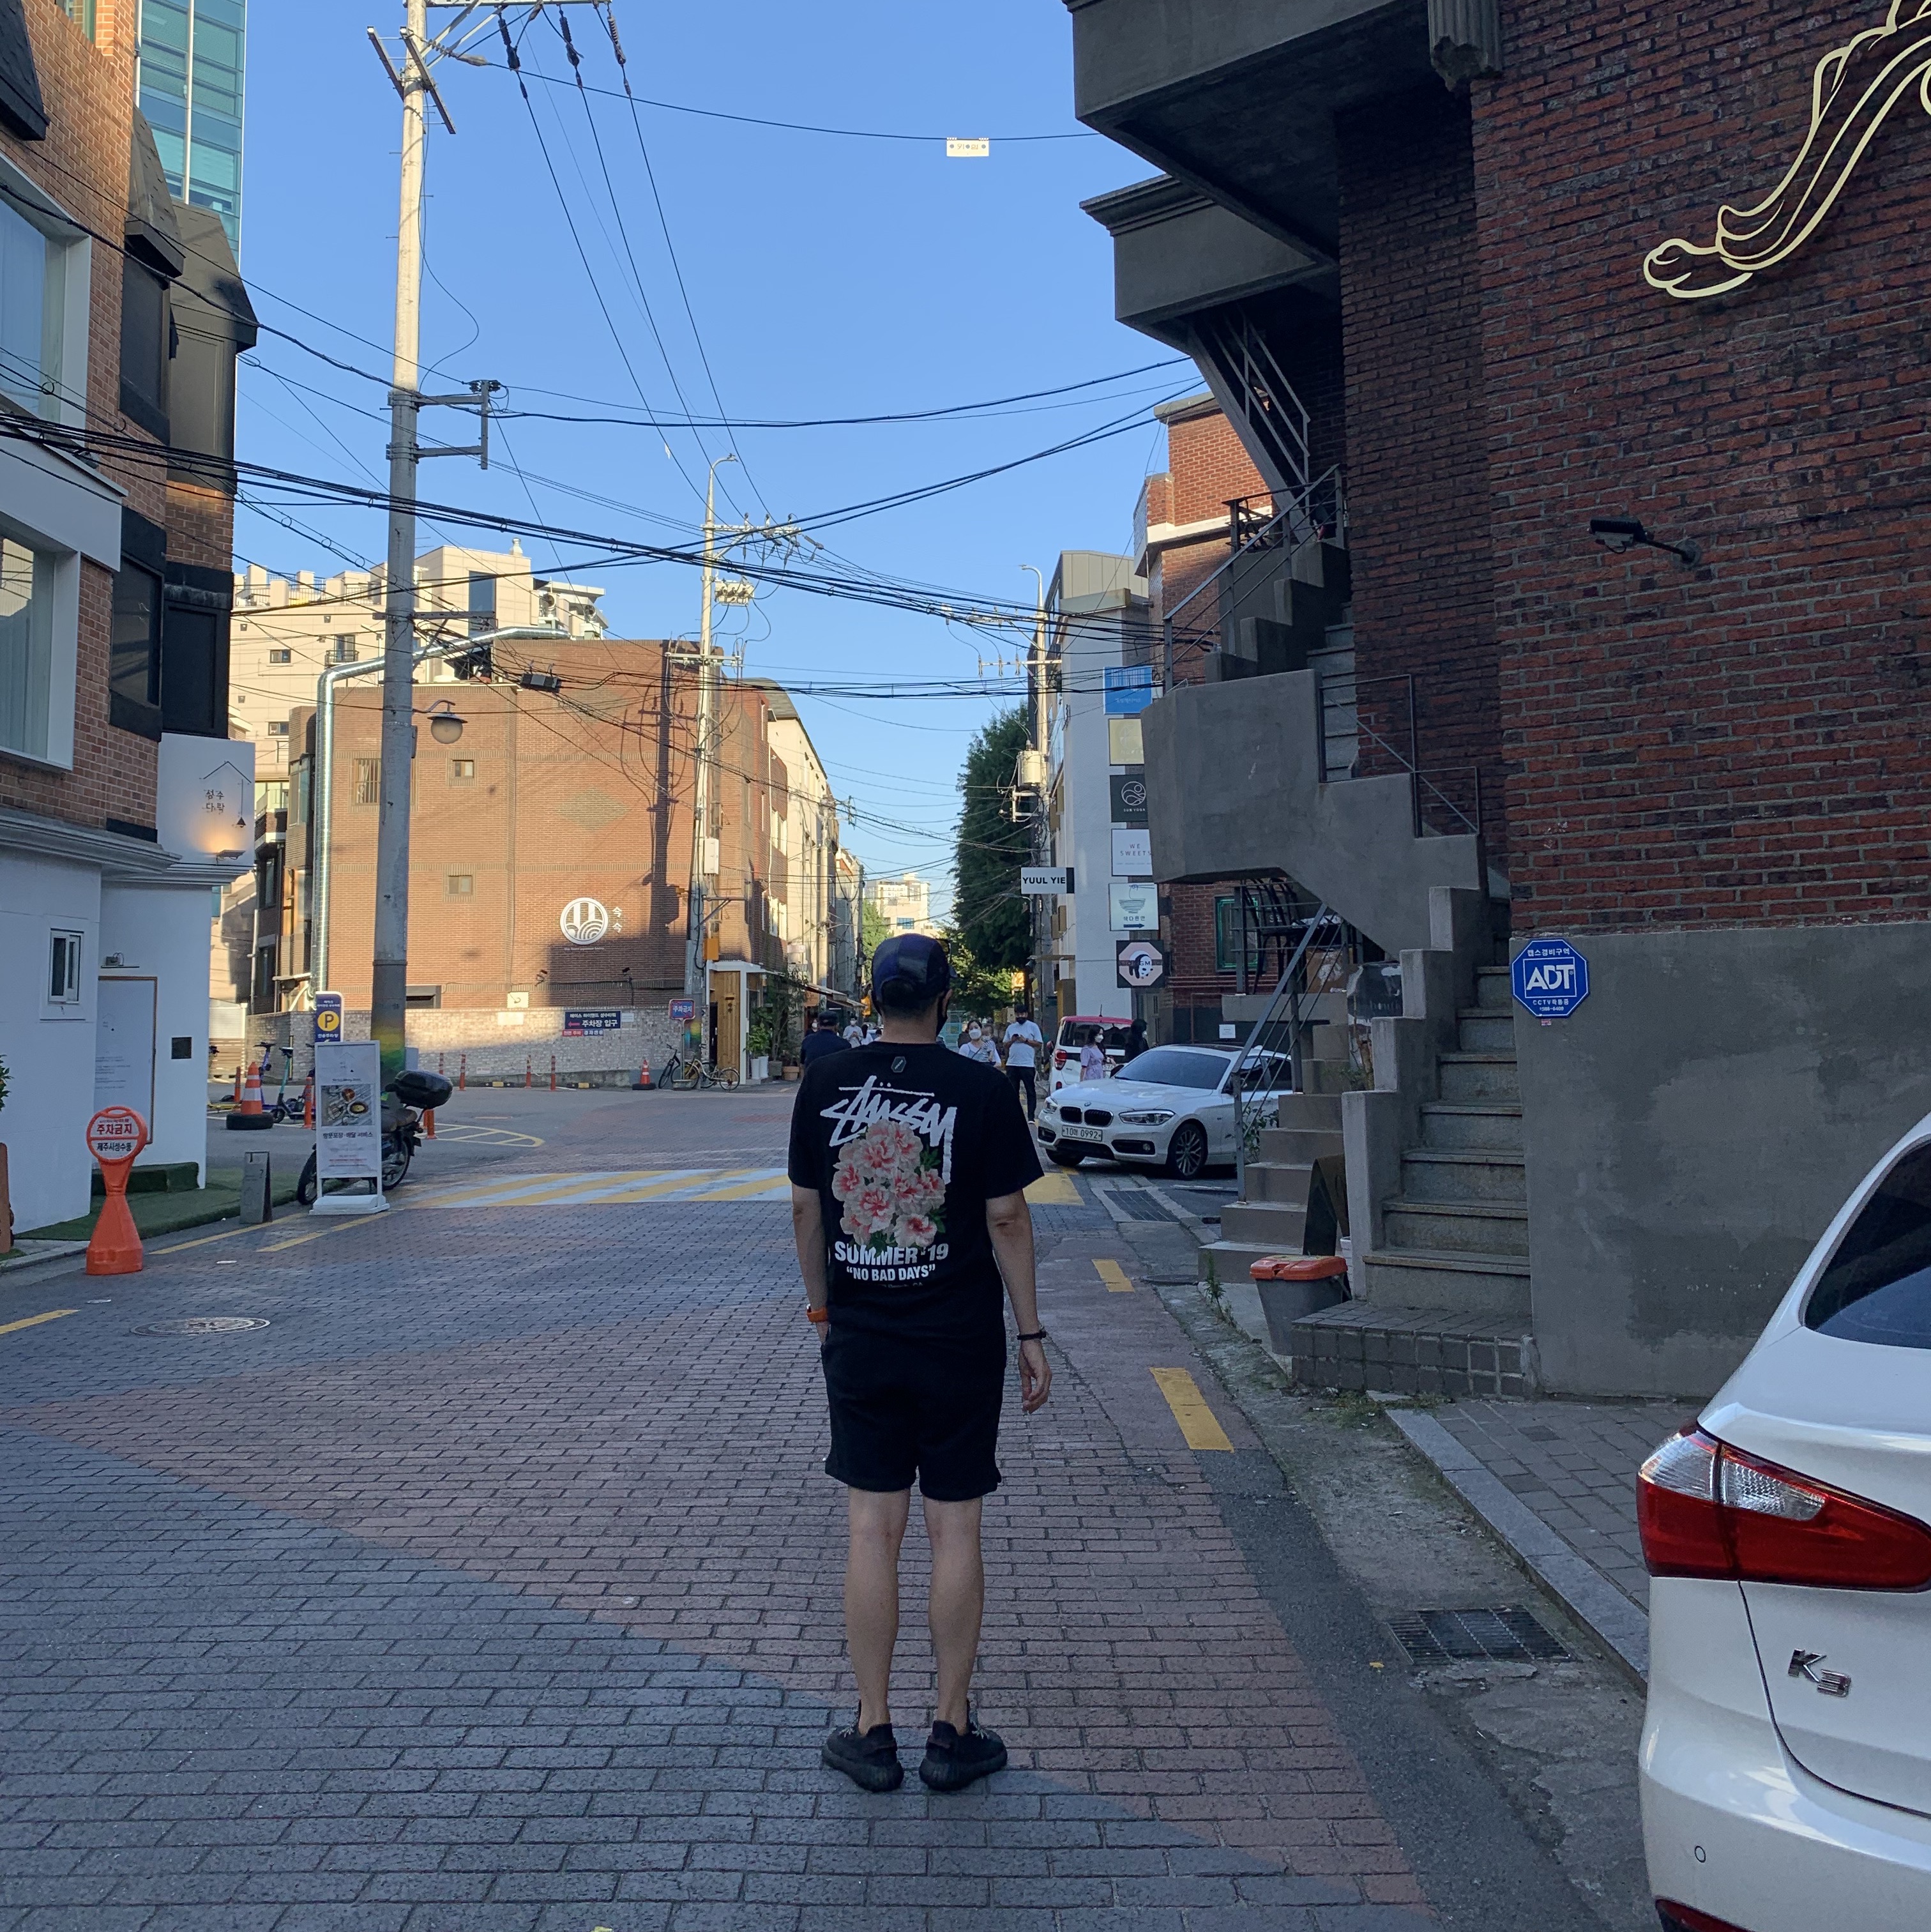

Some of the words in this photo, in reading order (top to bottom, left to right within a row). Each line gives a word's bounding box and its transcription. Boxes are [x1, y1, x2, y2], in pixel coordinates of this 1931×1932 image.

[206, 789, 225, 800] 성수
[206, 803, 225, 814] 다락
[1526, 964, 1573, 990] ADT
[324, 1014, 334, 1028] P
[97, 1123, 132, 1135] 주차금지
[835, 1241, 918, 1265] SUMMER
[871, 1268, 895, 1281] BAD
[1788, 1648, 1851, 1698] K3
